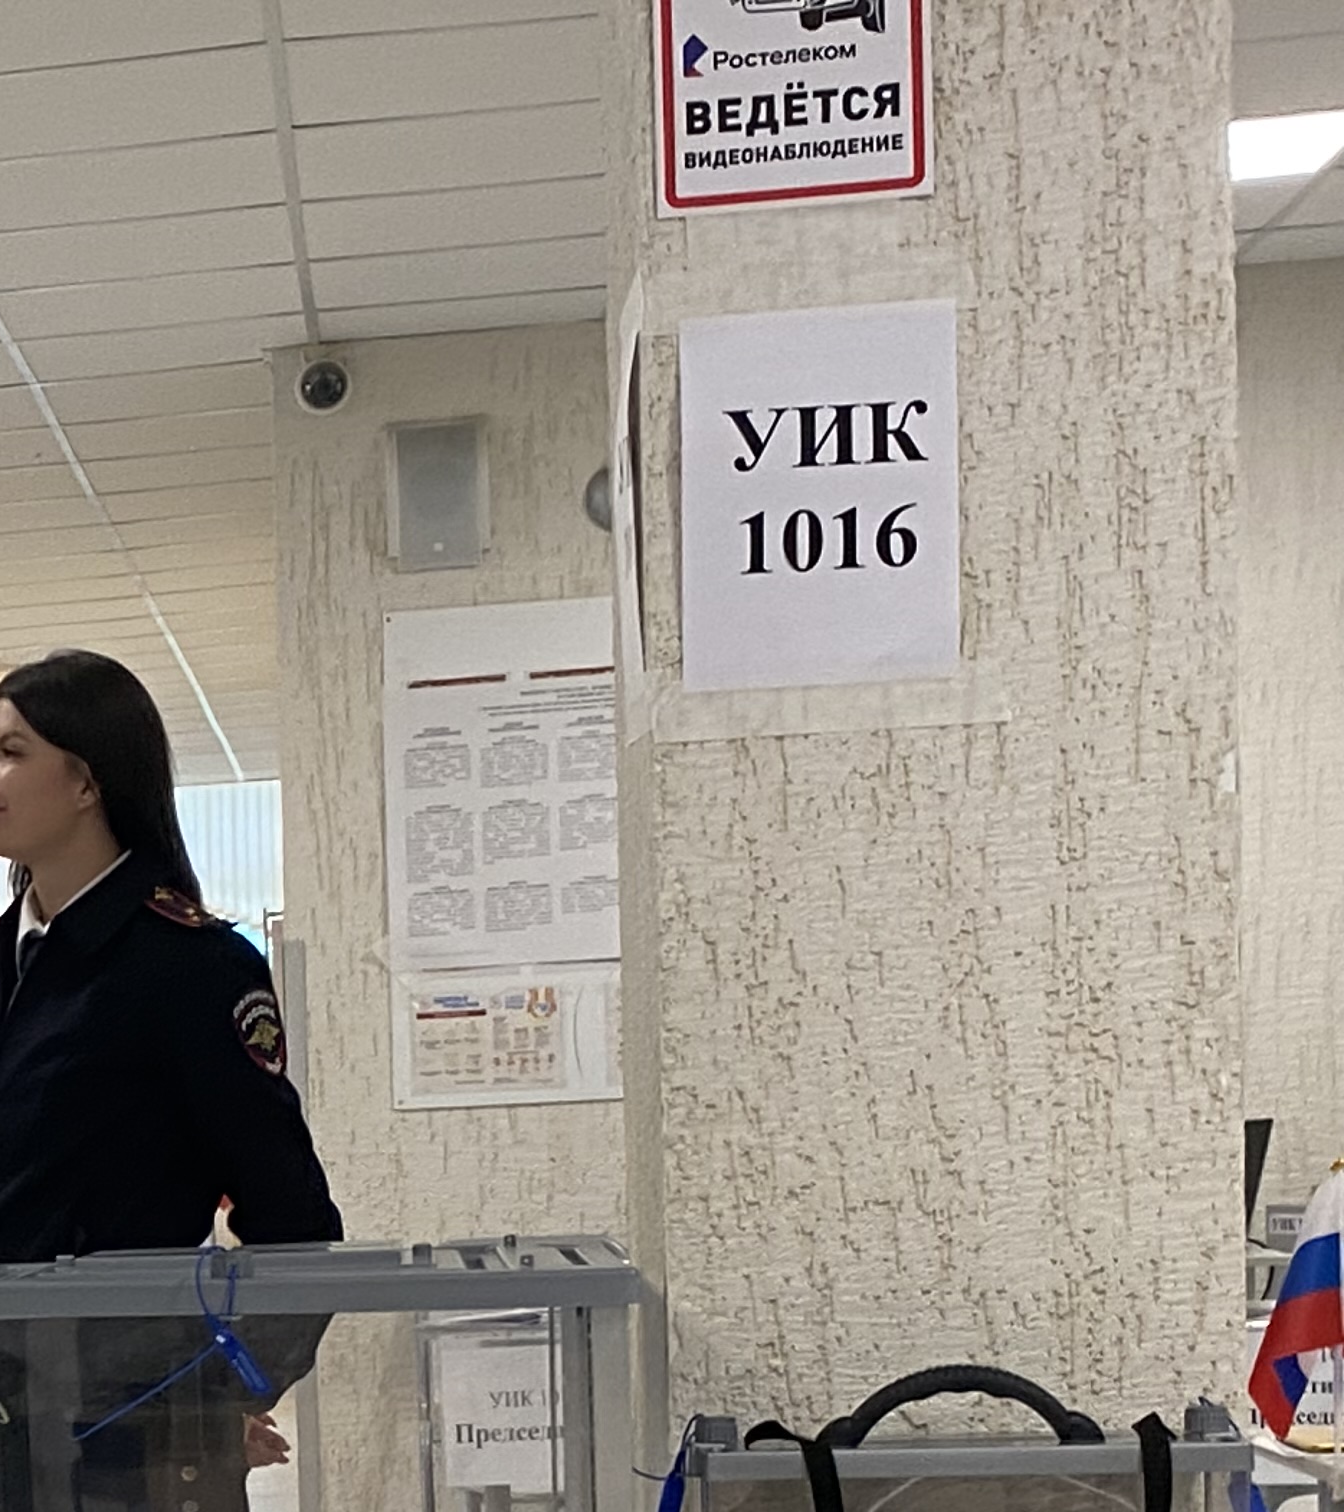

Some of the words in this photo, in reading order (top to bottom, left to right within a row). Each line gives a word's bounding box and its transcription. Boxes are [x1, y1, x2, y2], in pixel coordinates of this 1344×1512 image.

[713, 43, 857, 71] Ростелеком
[685, 81, 901, 138] ВЕДЁТСЯ
[684, 133, 904, 170] ВИДЕОНАБЛЮДЕНИЕ
[722, 399, 929, 473] УИК
[739, 503, 918, 575] 1016
[488, 1388, 534, 1409] УИК
